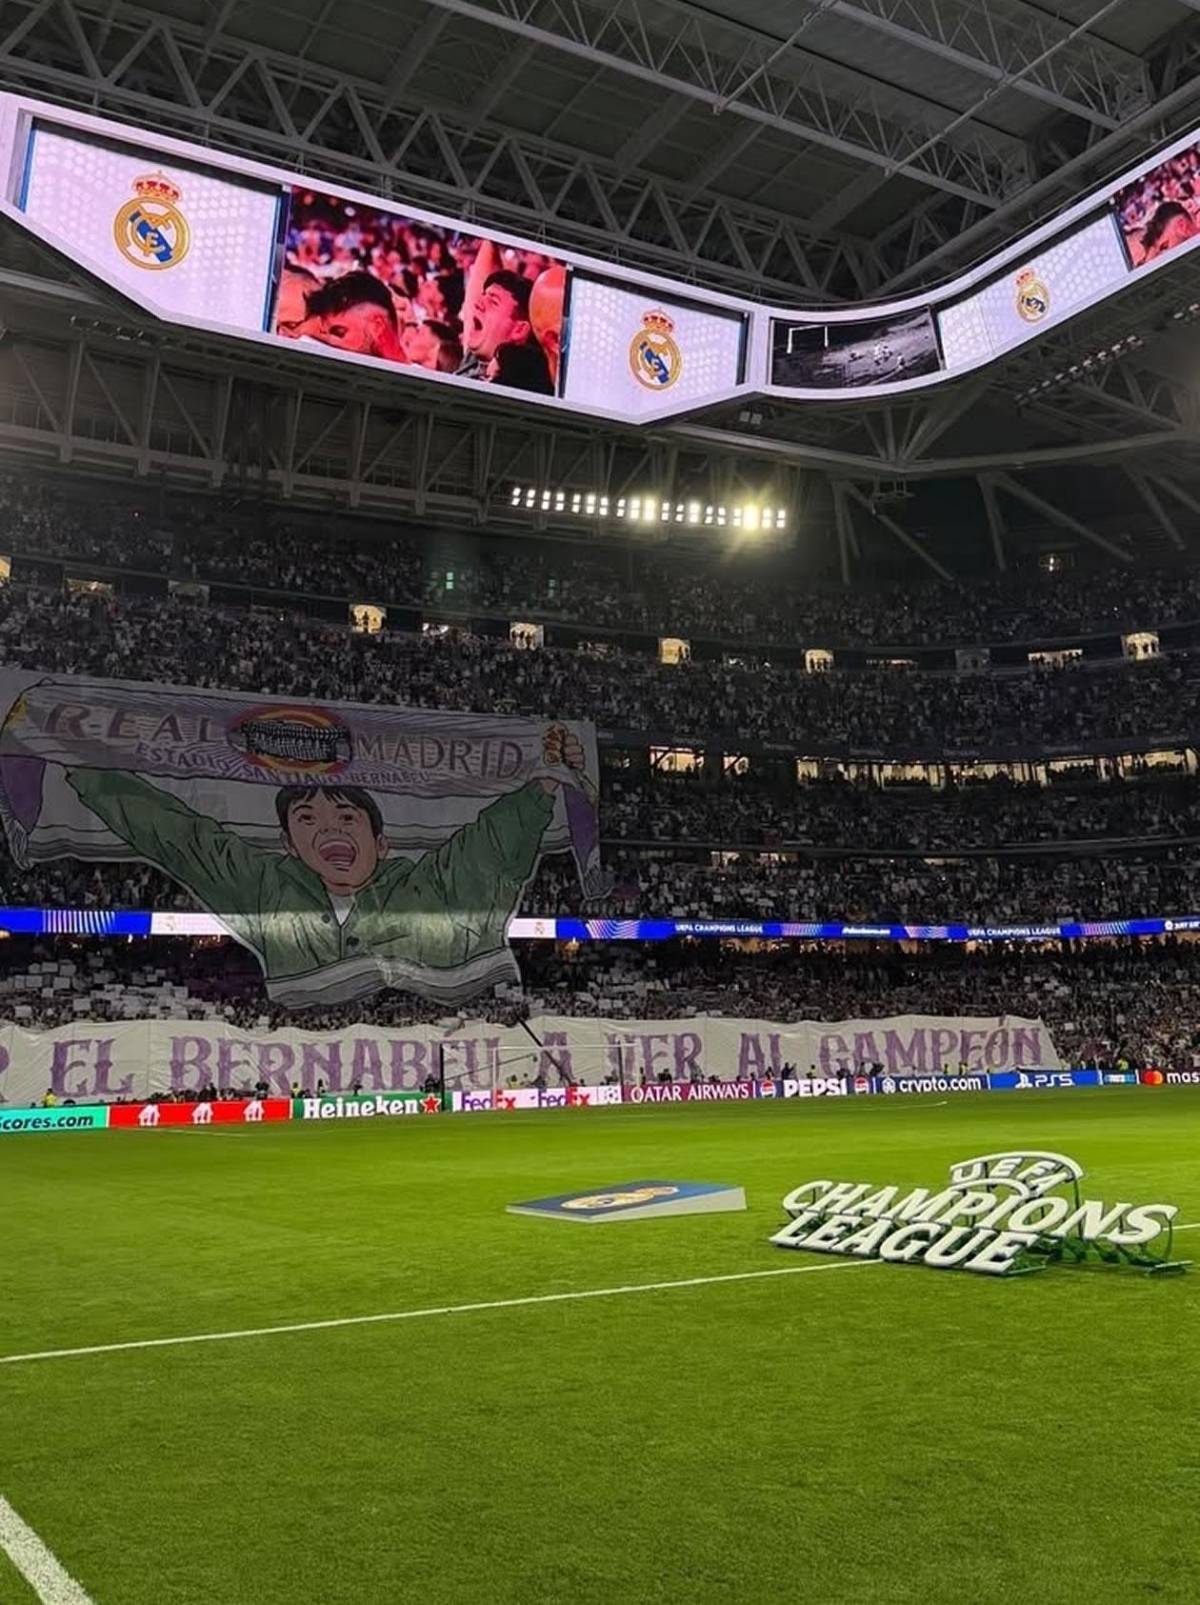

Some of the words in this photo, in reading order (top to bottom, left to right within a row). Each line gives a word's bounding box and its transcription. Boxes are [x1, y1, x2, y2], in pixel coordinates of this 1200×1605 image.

[41, 703, 226, 743] REAL
[351, 732, 524, 781] MADRID
[135, 741, 232, 772] ESTADIO
[987, 927, 1030, 937] CHAMPIONS
[1031, 926, 1062, 937] LEAGUE
[51, 1037, 135, 1098] EL
[630, 1085, 682, 1103] QATAR
[687, 1082, 749, 1100] AIRWAYS
[784, 1078, 847, 1098] PEPSI
[899, 1076, 981, 1094] crypto.com
[303, 1095, 418, 1119] Heineken
[461, 1089, 516, 1110] FedEx
[537, 1086, 590, 1108] FedEx
[0, 1115, 94, 1131] cores.com
[951, 1157, 1074, 1200] UEFA
[782, 1179, 1179, 1246] CHAMPIONS
[769, 1211, 1038, 1275] LEAGUE
